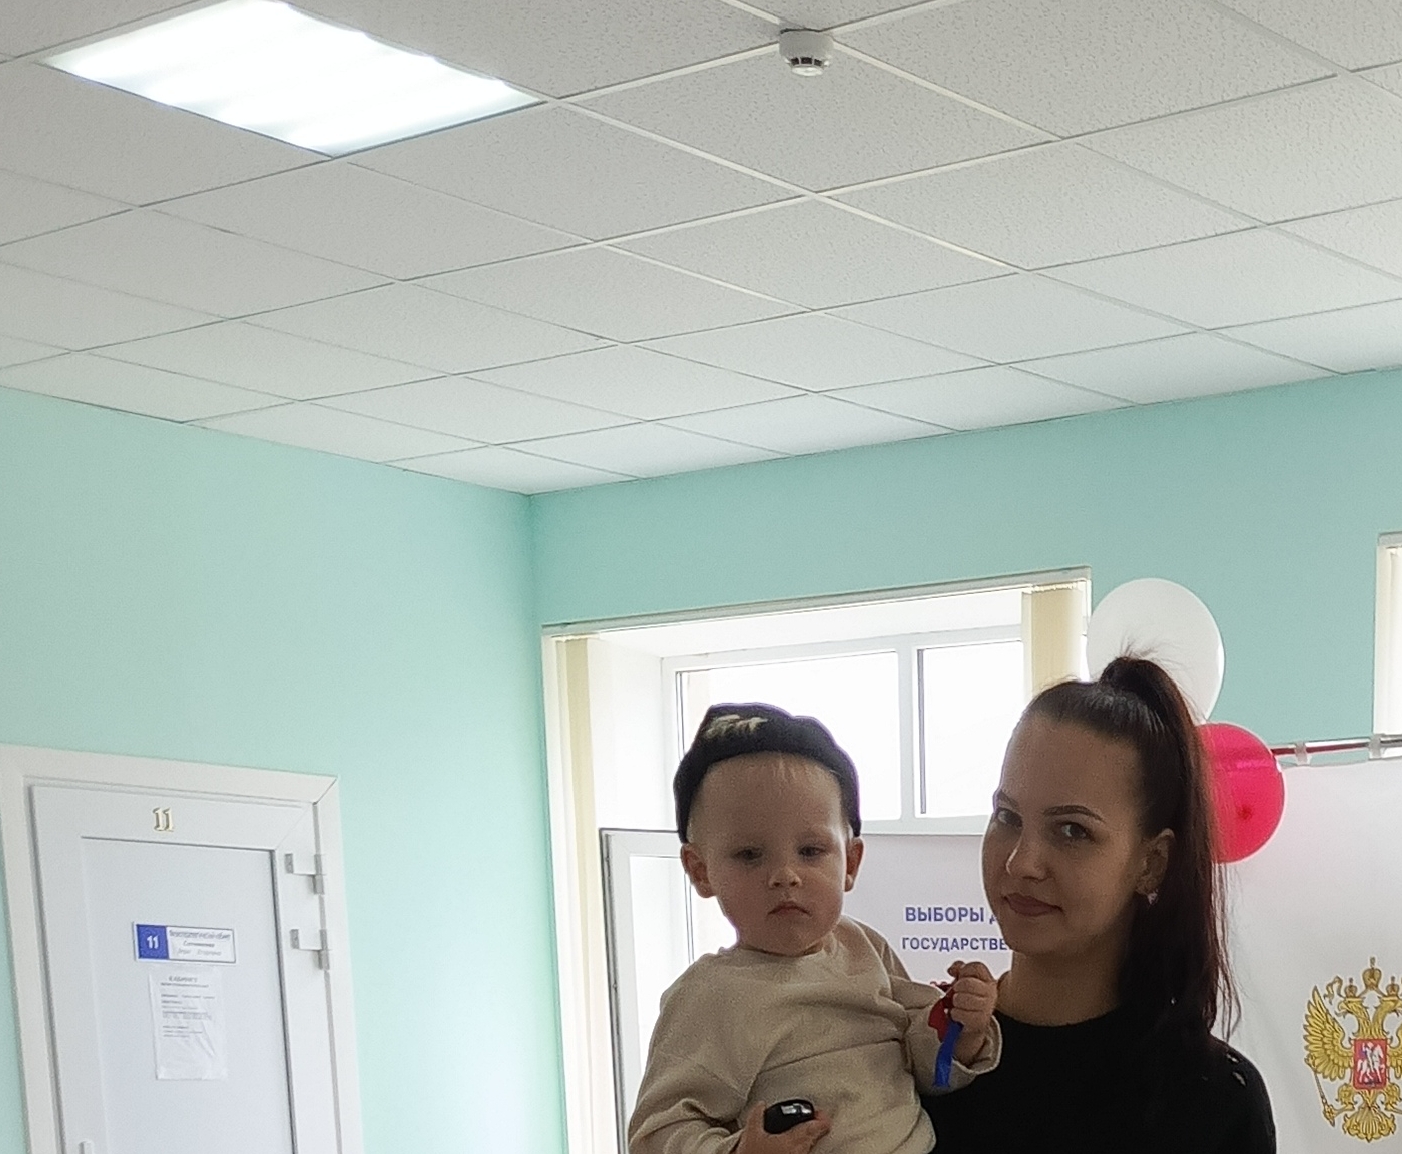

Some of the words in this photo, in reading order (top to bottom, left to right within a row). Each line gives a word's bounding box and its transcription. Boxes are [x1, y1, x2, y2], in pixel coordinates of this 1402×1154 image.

[153, 807, 174, 832] 11
[905, 907, 985, 922] ВЫБОРЫ
[147, 935, 159, 949] 11
